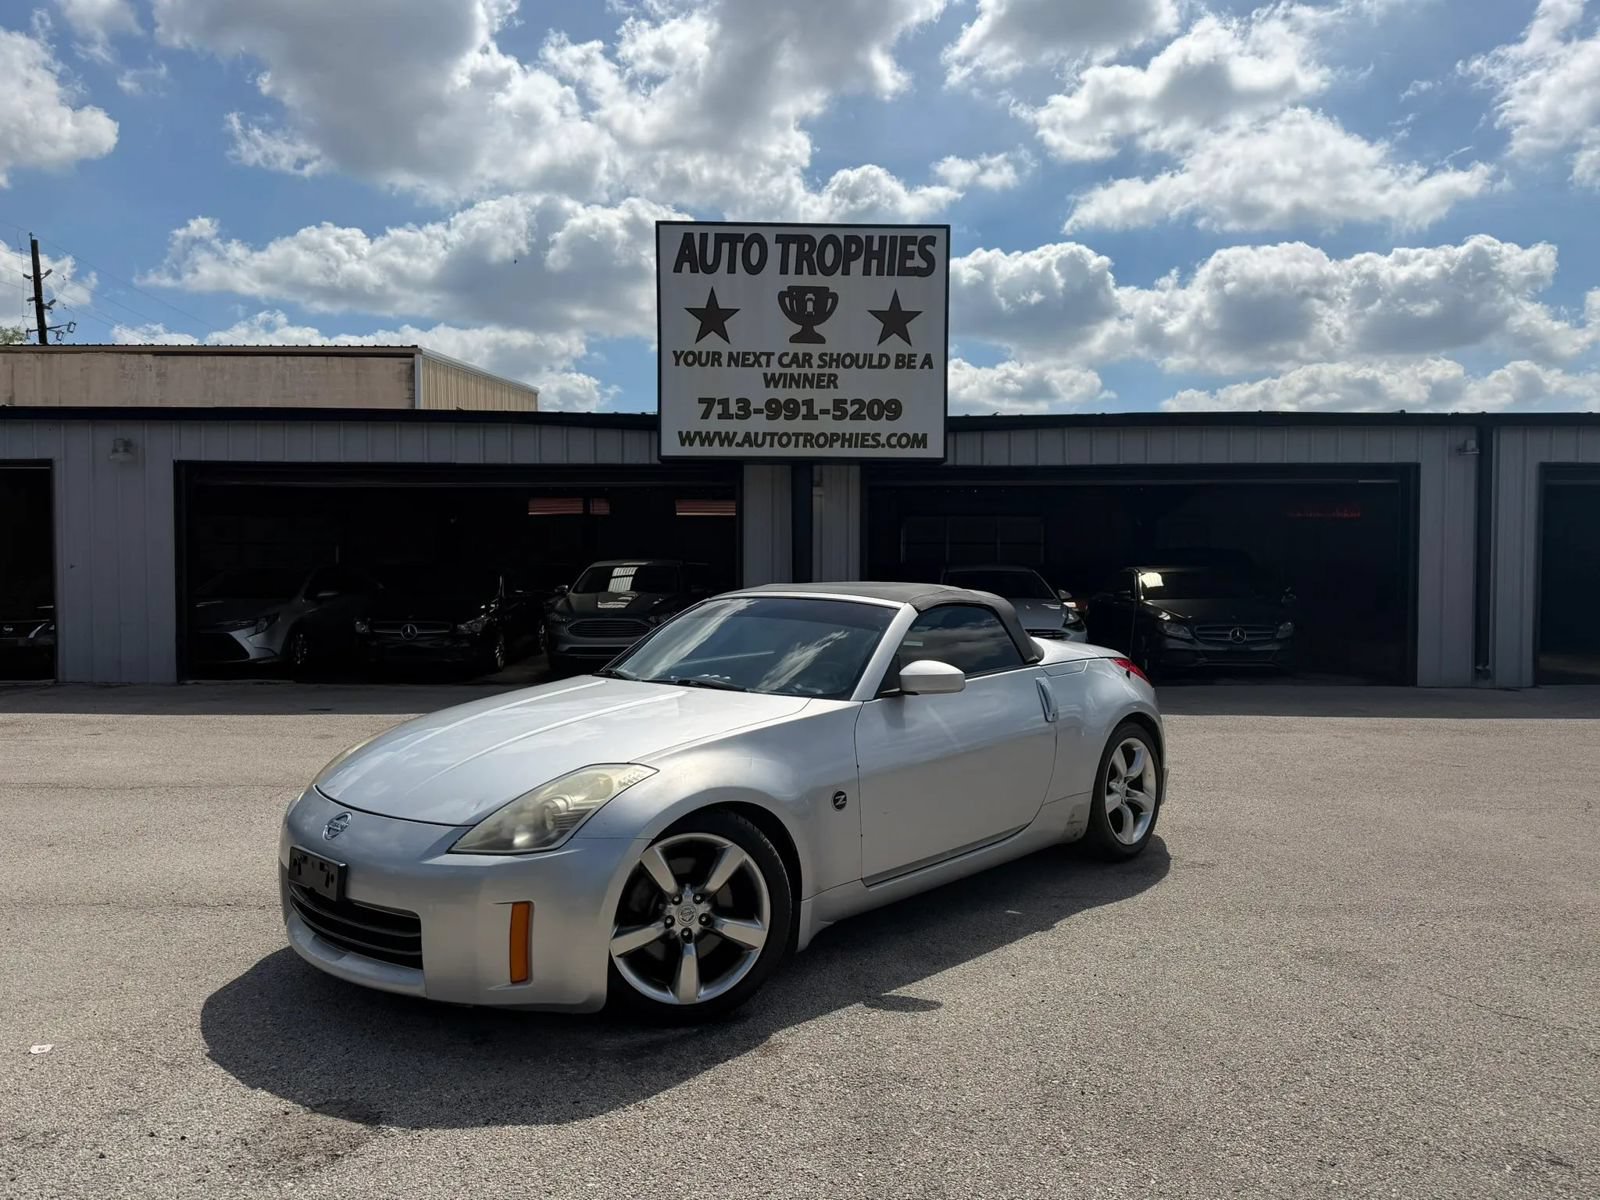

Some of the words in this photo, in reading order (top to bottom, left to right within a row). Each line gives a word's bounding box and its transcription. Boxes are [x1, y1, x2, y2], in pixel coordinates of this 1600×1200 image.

[673, 232, 768, 275] AUTO
[775, 233, 937, 278] TROPHIES
[672, 350, 722, 368] YOUR
[727, 351, 775, 368] NEXT
[778, 352, 812, 369] CAR
[817, 352, 890, 370] SHOULD
[894, 353, 917, 369] BE
[920, 353, 934, 369] A
[763, 372, 839, 389] WINNER
[698, 397, 902, 421] 713-991-5209
[678, 430, 928, 449] WWW.AUTOTROPHIES.COM
